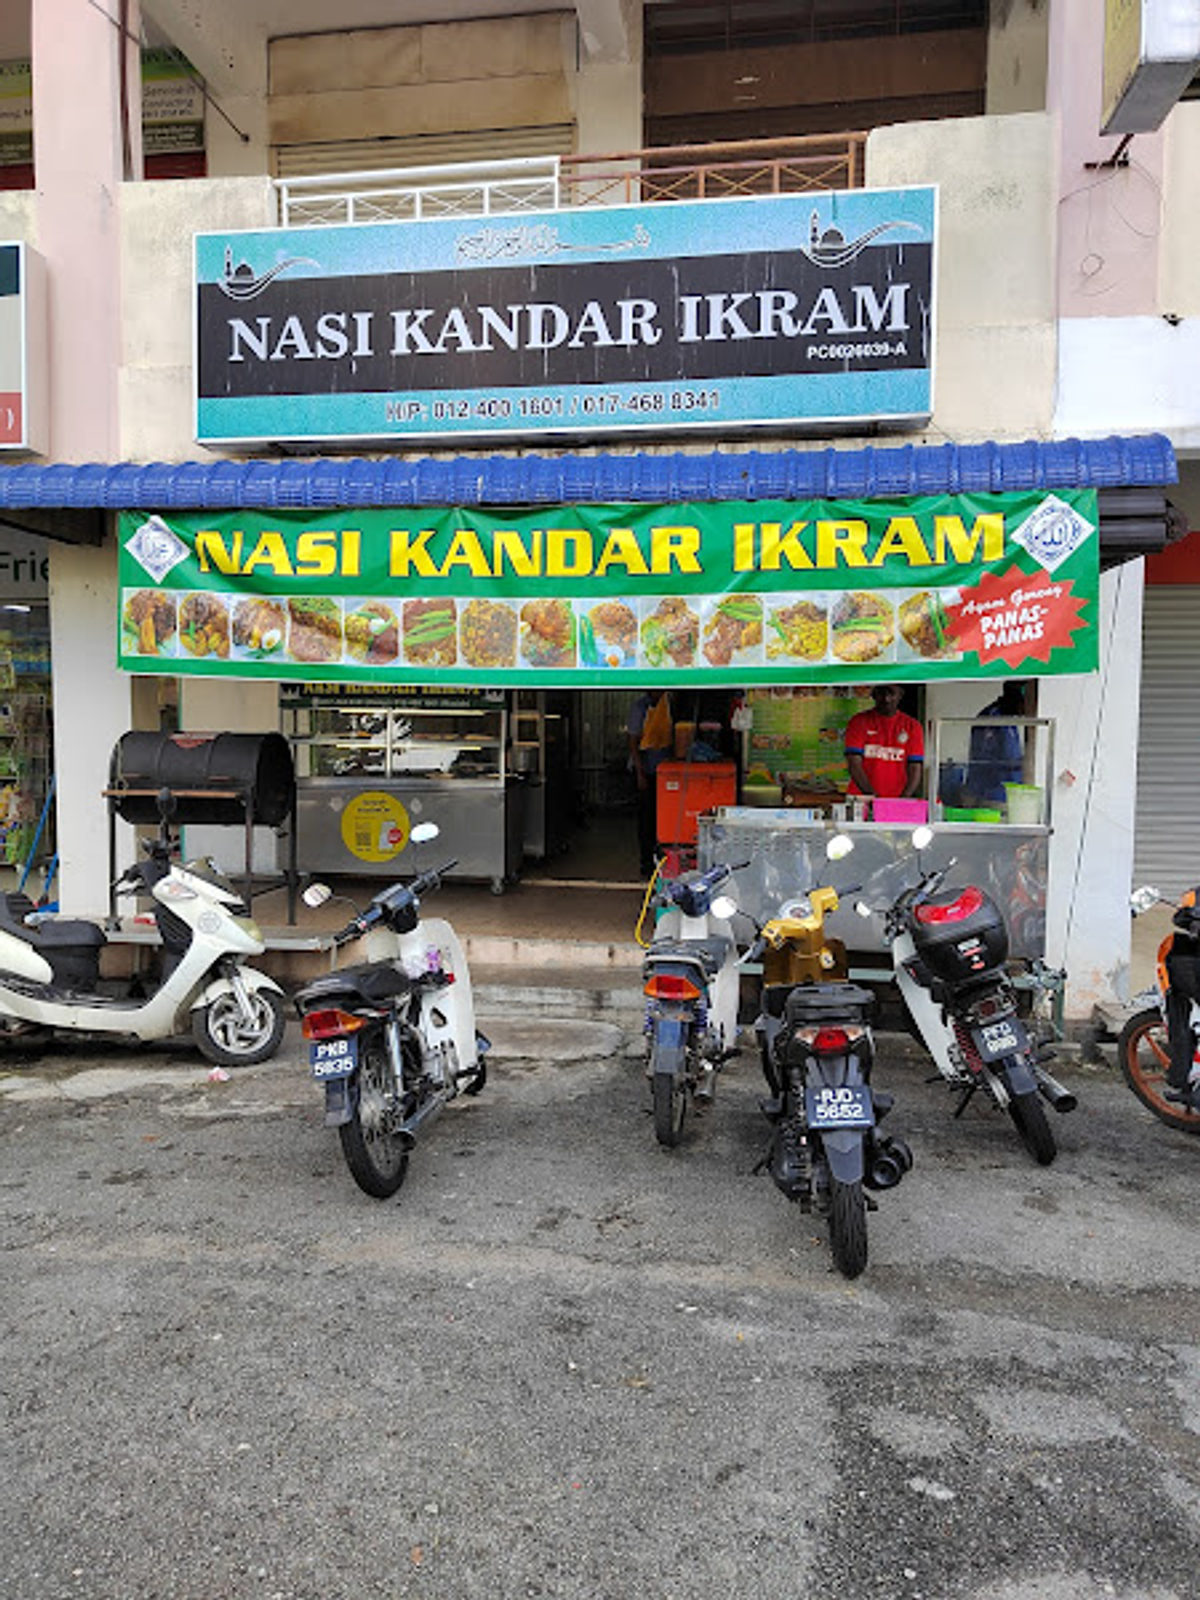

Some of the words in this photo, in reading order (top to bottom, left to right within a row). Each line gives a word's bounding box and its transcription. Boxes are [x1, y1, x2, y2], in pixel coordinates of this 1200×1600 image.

[227, 312, 374, 361] NASI
[390, 298, 662, 355] KANDAR
[678, 283, 912, 343] IKRAM
[670, 389, 719, 410] 8341
[195, 529, 362, 577] NASI
[388, 526, 703, 577] KANDAR
[733, 512, 1007, 572] IKRAM
[980, 604, 1049, 633] PANAS-
[984, 621, 1045, 650] PANAS
[317, 1040, 349, 1059] PKB
